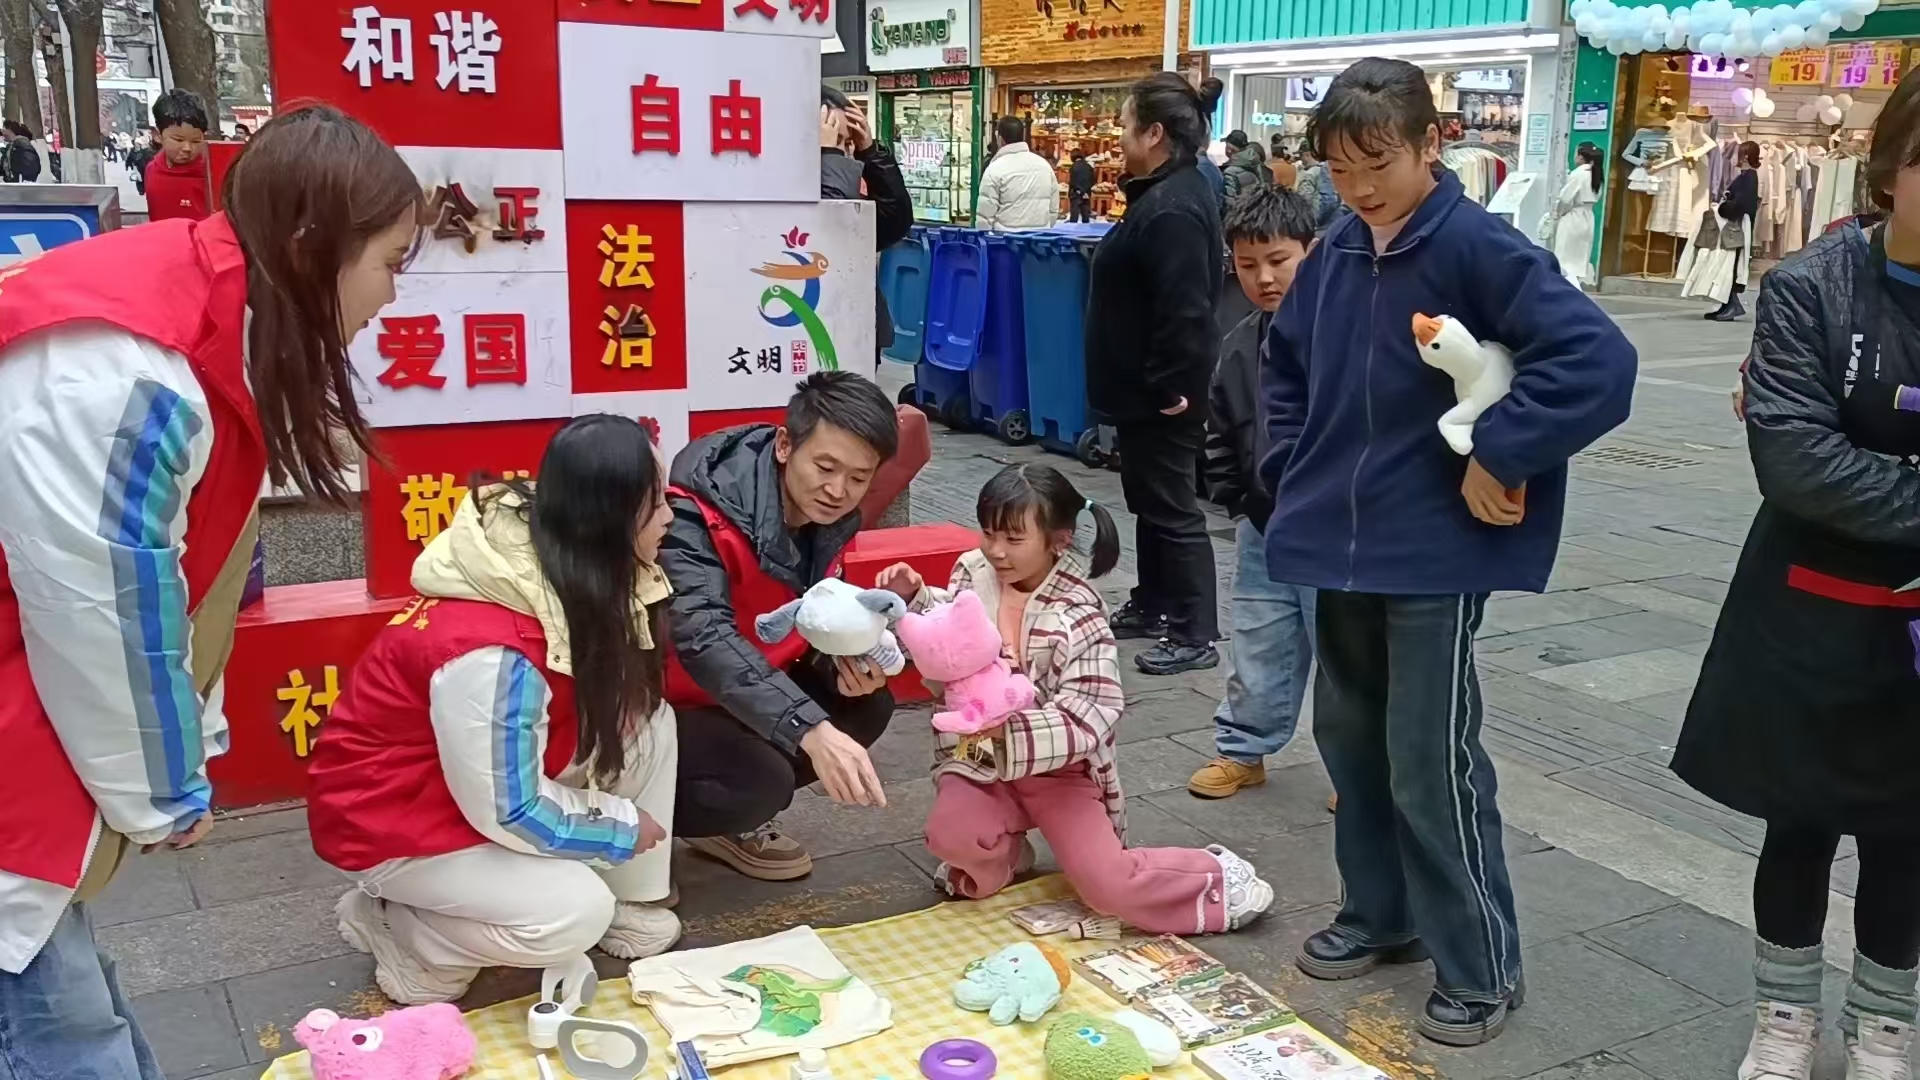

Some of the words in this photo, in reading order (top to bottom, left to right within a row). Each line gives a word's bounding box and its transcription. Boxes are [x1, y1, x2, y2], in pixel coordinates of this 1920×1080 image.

[341, 6, 502, 93] 和谐
[1790, 63, 1816, 82] 19
[1843, 66, 1867, 84] 19
[631, 74, 762, 157] 自由
[596, 223, 656, 369] 法治
[376, 313, 528, 389] 爱国
[727, 345, 782, 375] 文明
